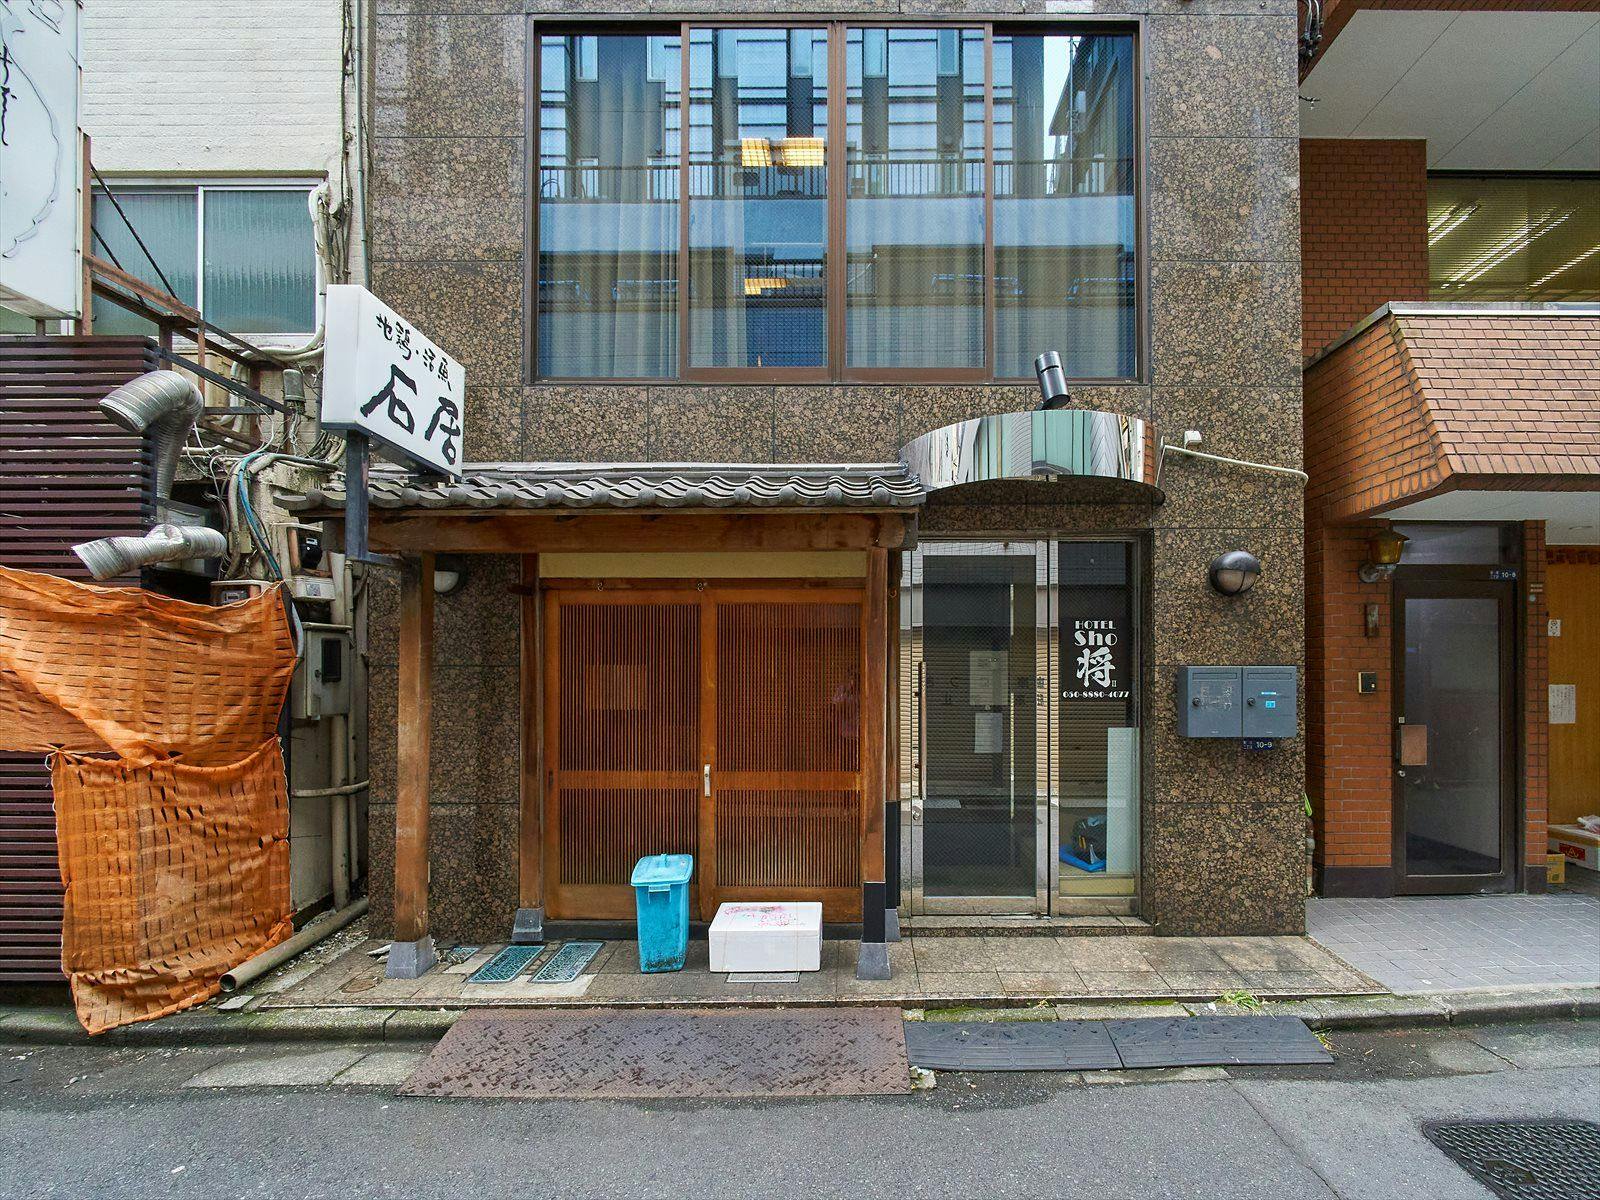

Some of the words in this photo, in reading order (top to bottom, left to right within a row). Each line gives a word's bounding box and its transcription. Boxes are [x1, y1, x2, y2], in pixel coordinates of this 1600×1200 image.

[360, 364, 461, 465] 石居
[1075, 620, 1116, 629] HOTEL
[1074, 630, 1118, 646] Sho
[1076, 646, 1116, 688] 将
[1062, 690, 1129, 698] 050-8880-4077
